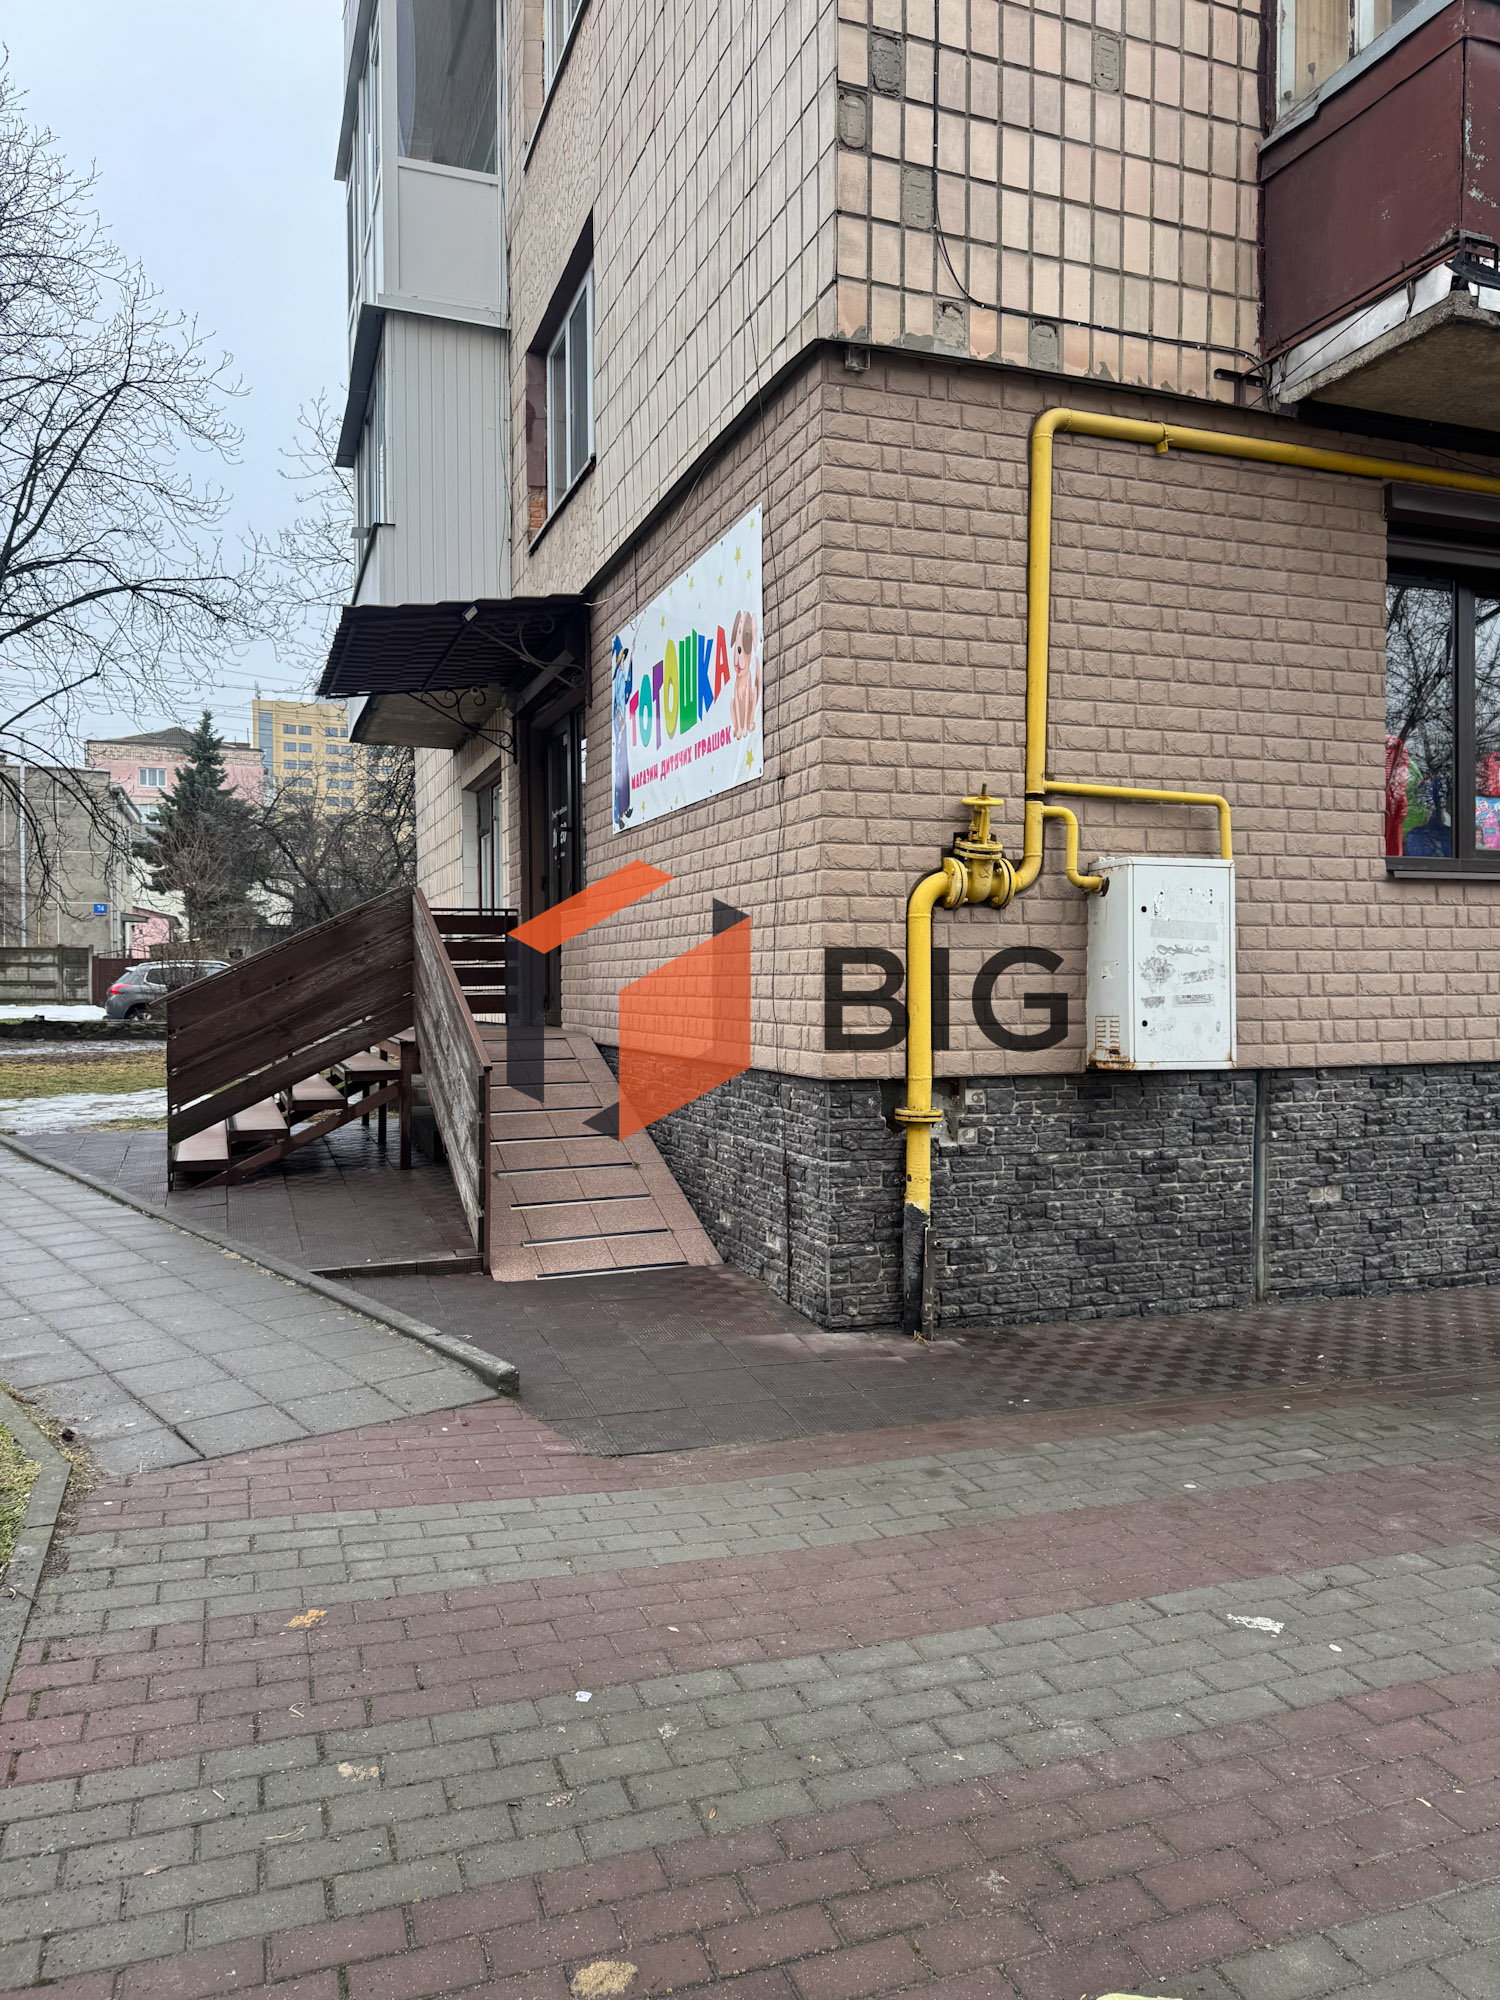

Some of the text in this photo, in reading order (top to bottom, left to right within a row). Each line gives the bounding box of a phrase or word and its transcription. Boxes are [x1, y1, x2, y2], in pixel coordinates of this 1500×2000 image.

[629, 625, 731, 750] ТОТОШКА
[631, 725, 732, 790] МАГАЗИН ДИТЯЧИХ ІГРАШОК
